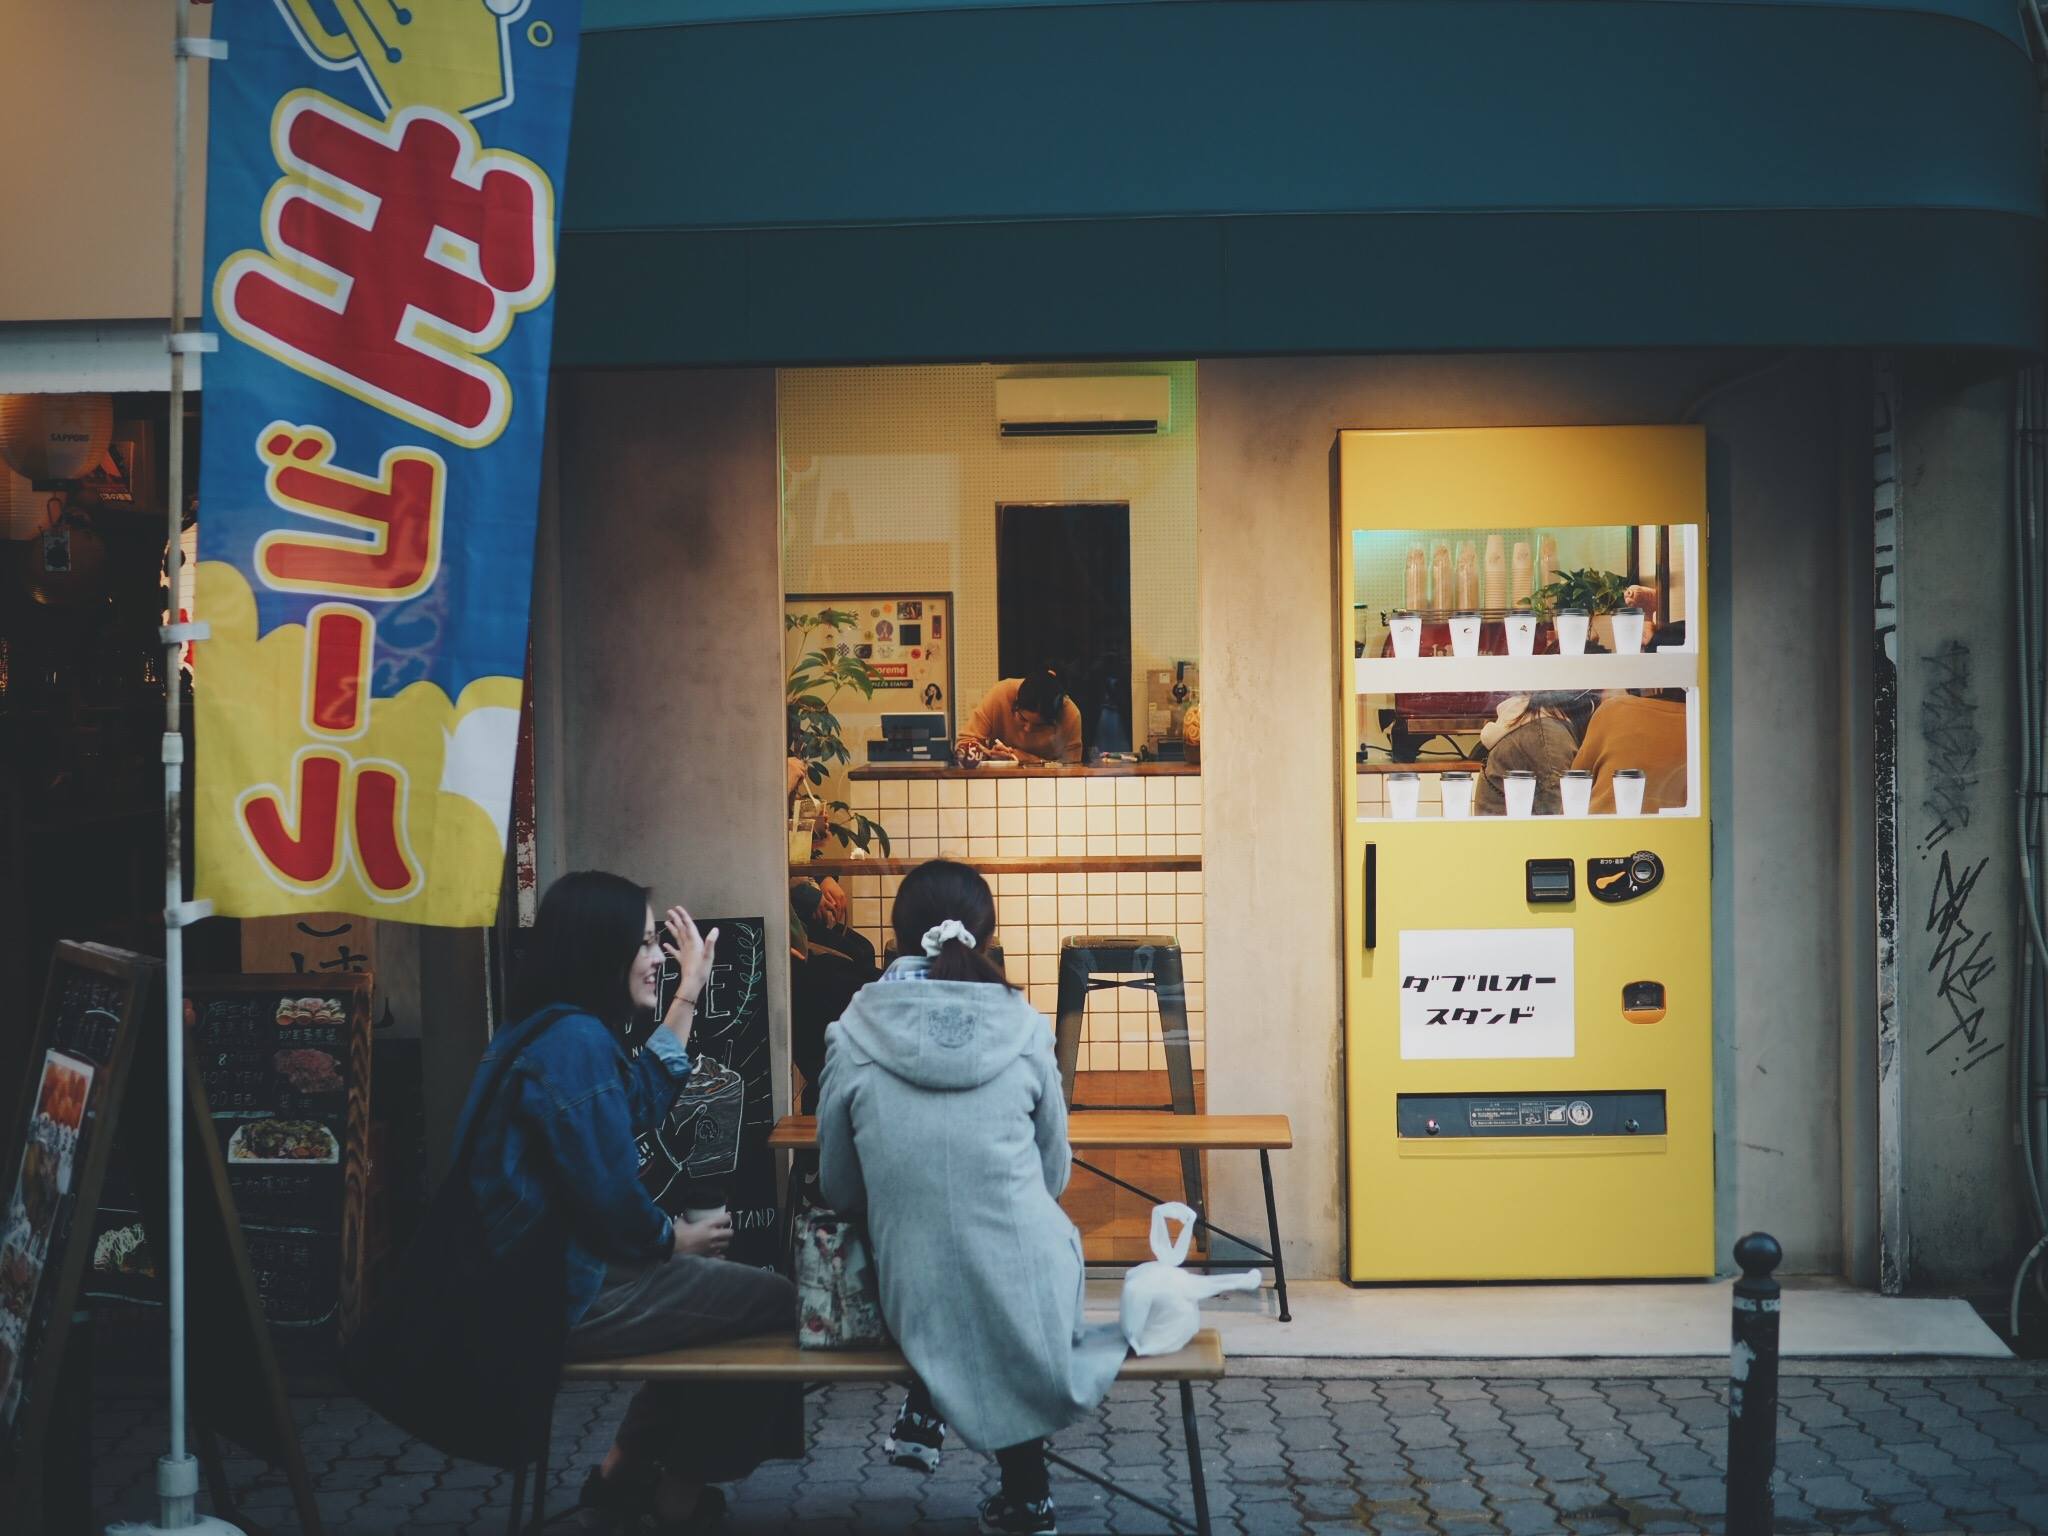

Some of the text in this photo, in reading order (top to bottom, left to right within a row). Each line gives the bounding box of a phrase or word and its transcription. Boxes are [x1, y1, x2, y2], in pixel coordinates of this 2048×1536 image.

[1402, 973, 1556, 992] ダブルオー
[1425, 1005, 1535, 1025] スタンド
